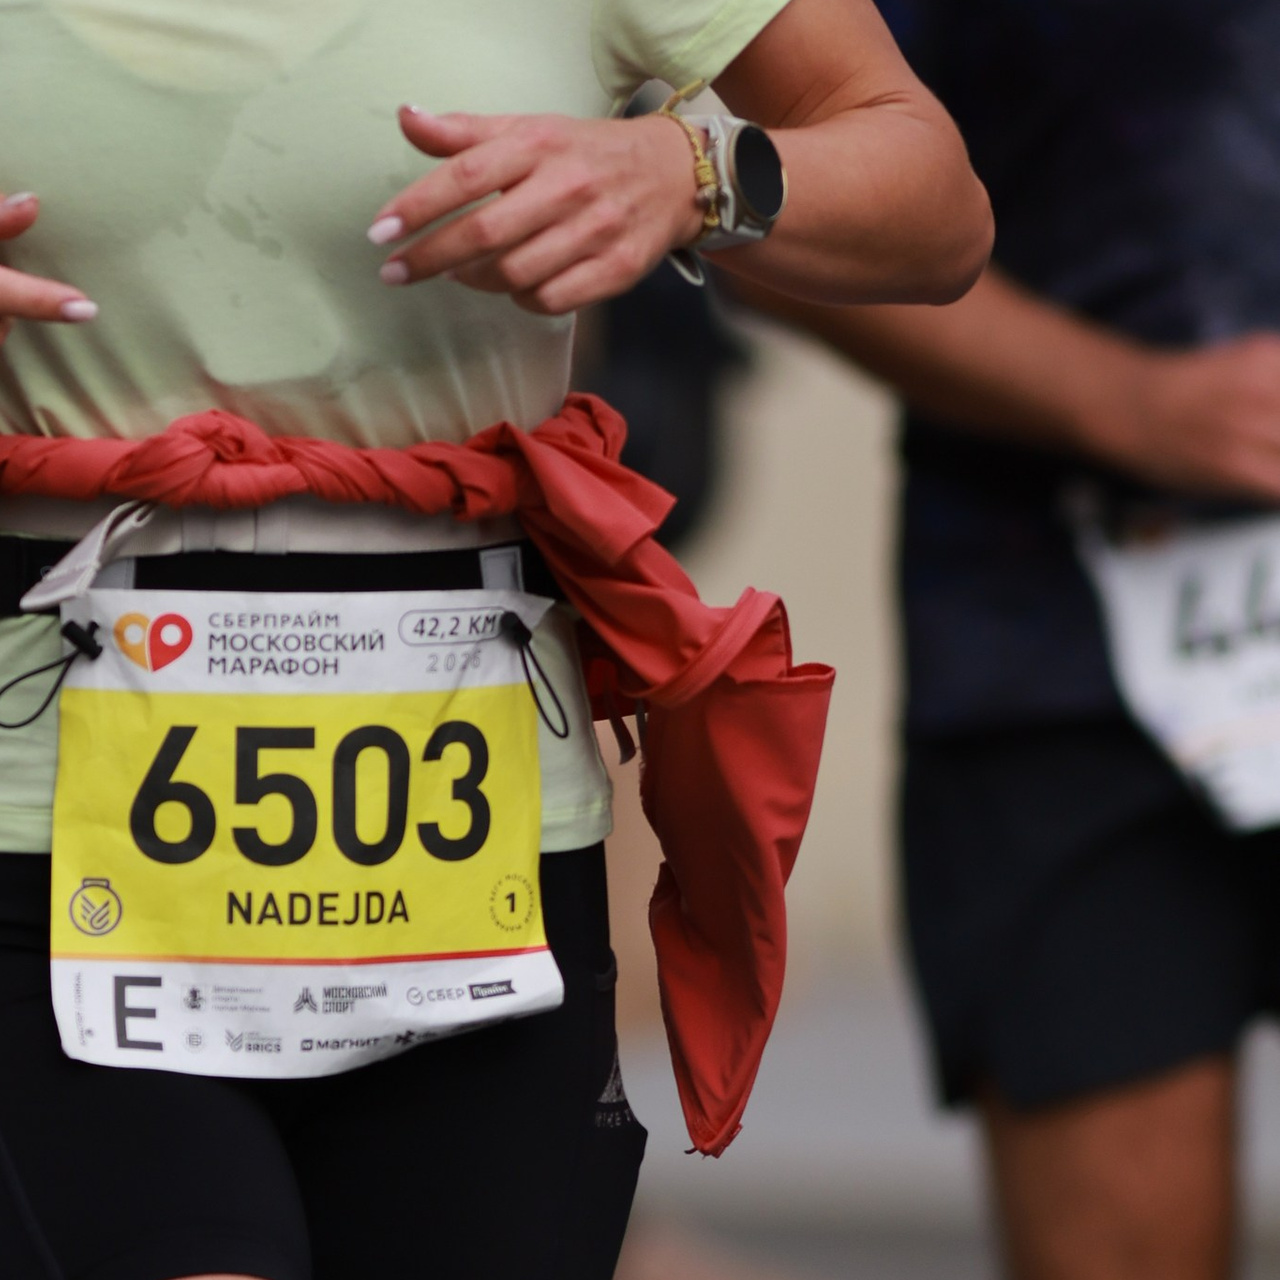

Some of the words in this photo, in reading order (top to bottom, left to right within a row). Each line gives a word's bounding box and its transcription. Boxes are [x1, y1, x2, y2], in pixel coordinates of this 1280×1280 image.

[207, 610, 339, 628] СБЕРПРАЙМ
[413, 616, 460, 639] 42,2
[468, 614, 497, 635] КМ
[208, 630, 385, 652] МОСКОВСКИЙ
[208, 656, 339, 676] МАРАФОН
[130, 720, 491, 866] 6503
[227, 890, 410, 926] NADEJDA
[504, 891, 516, 914] 1
[323, 981, 387, 999] МОСКОВСКИЙ
[426, 987, 465, 1002] СБЕР
[114, 976, 163, 1051] E
[322, 1001, 355, 1014] СПОРТ
[245, 1043, 282, 1053] BRICS
[316, 1037, 380, 1052] магнит
